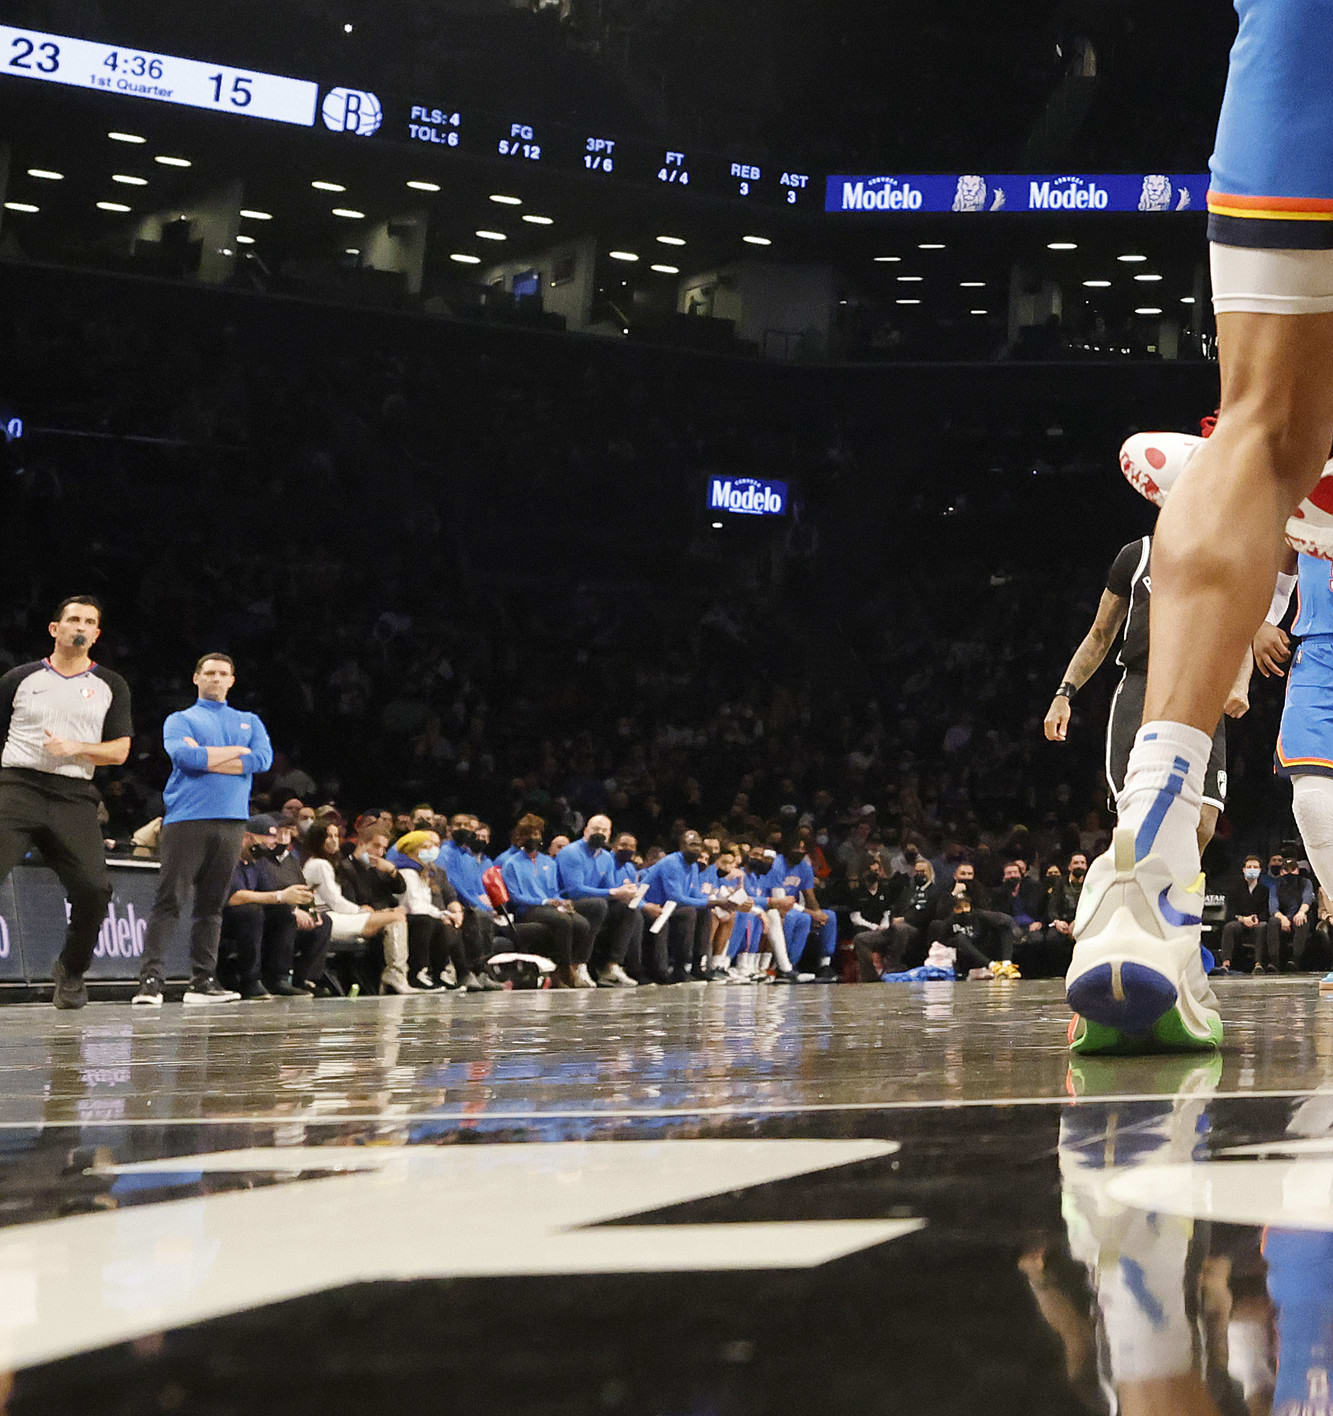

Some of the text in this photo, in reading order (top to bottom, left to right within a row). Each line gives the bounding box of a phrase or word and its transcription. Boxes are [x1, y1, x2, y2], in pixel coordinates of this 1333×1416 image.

[9, 37, 61, 73] 23
[103, 51, 164, 81] 4:36
[208, 73, 254, 107] 15
[90, 74, 174, 99] 1st Quarter
[511, 124, 534, 140] FG
[586, 137, 615, 155] 3PT
[665, 151, 685, 167] FT
[730, 163, 761, 181] REB
[780, 173, 809, 189] AST
[740, 182, 749, 196] 3
[787, 190, 797, 204] 3
[842, 182, 922, 210] Modelo
[1028, 181, 1108, 209] Modelo
[711, 480, 782, 513] Modelo
